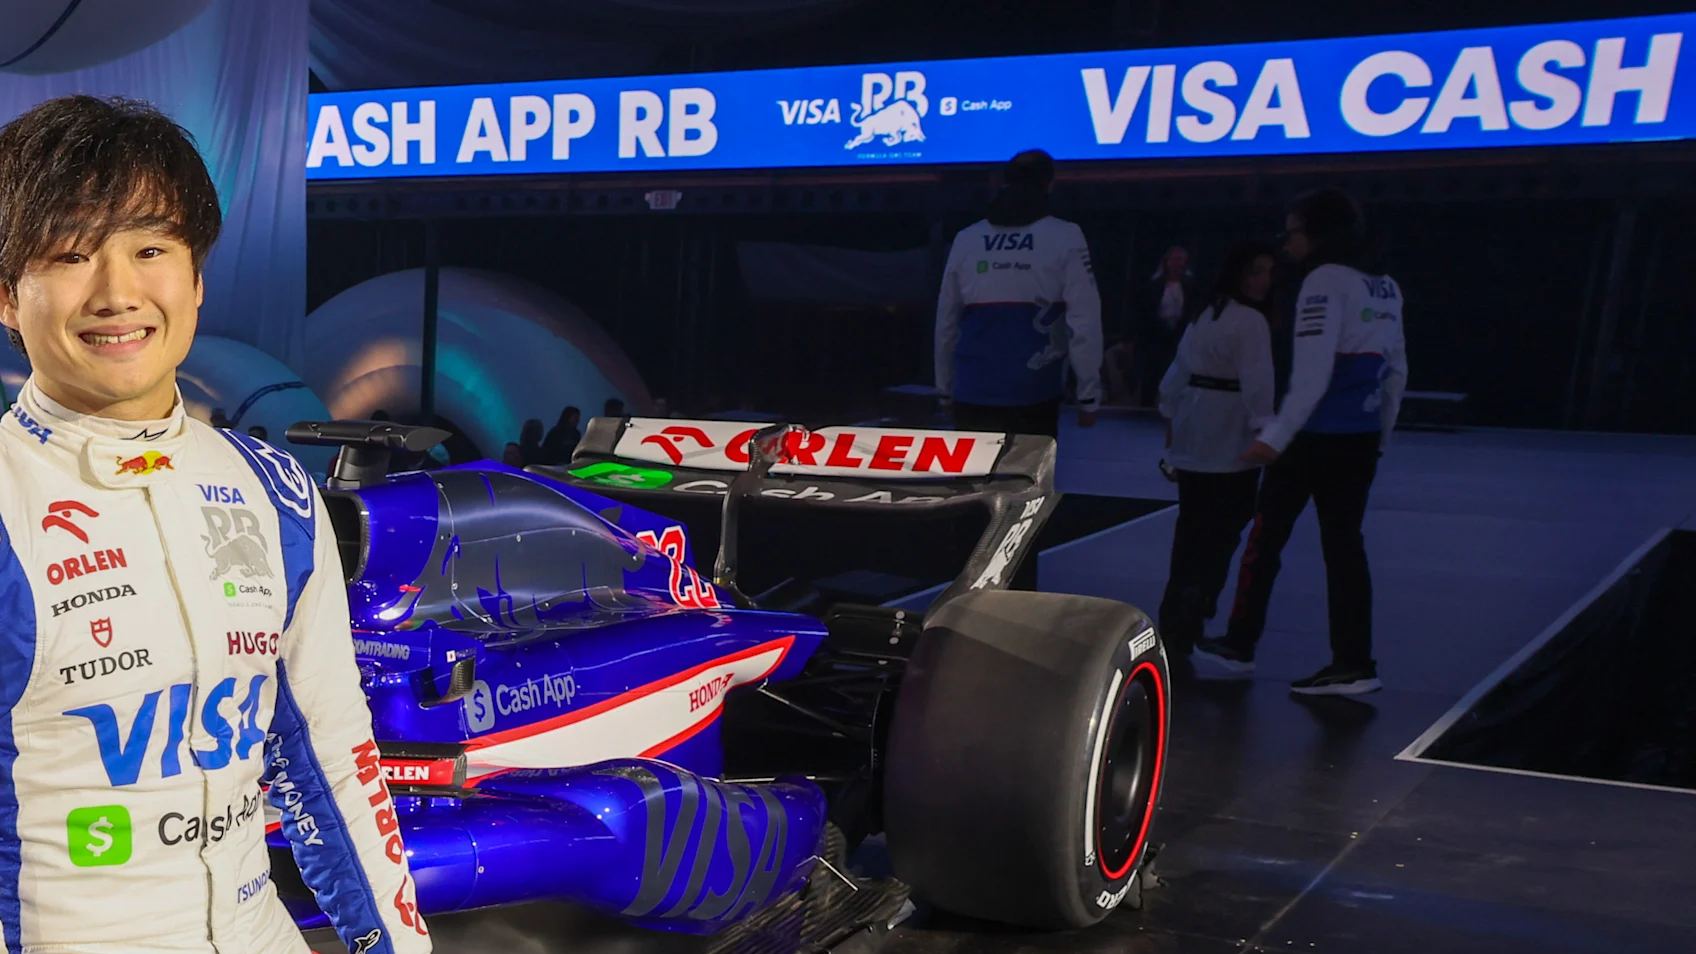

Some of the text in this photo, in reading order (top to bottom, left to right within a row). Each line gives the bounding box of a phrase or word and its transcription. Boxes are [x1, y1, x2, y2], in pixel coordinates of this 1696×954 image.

[961, 99, 1013, 112] Cash App
[1080, 32, 1684, 145] VISA CASH
[306, 88, 719, 168] ASH APP RB
[776, 98, 841, 125] VISA
[983, 233, 1034, 251] VISA
[195, 484, 246, 505] VISA
[672, 480, 836, 501] Csh
[46, 547, 127, 586] ORLEN
[51, 583, 138, 618] HONDA
[238, 585, 258, 594] Cash
[226, 631, 280, 656] HUGO
[59, 648, 153, 685] TUDOR
[495, 680, 541, 717] Cash
[542, 674, 575, 706] App
[689, 672, 735, 714] HONDA
[62, 674, 269, 787] VISA
[381, 766, 430, 781] RLEN
[274, 771, 324, 846] MONEY
[351, 738, 405, 865] ORLEN
[158, 805, 233, 846] Cash
[593, 766, 789, 921] VISA
